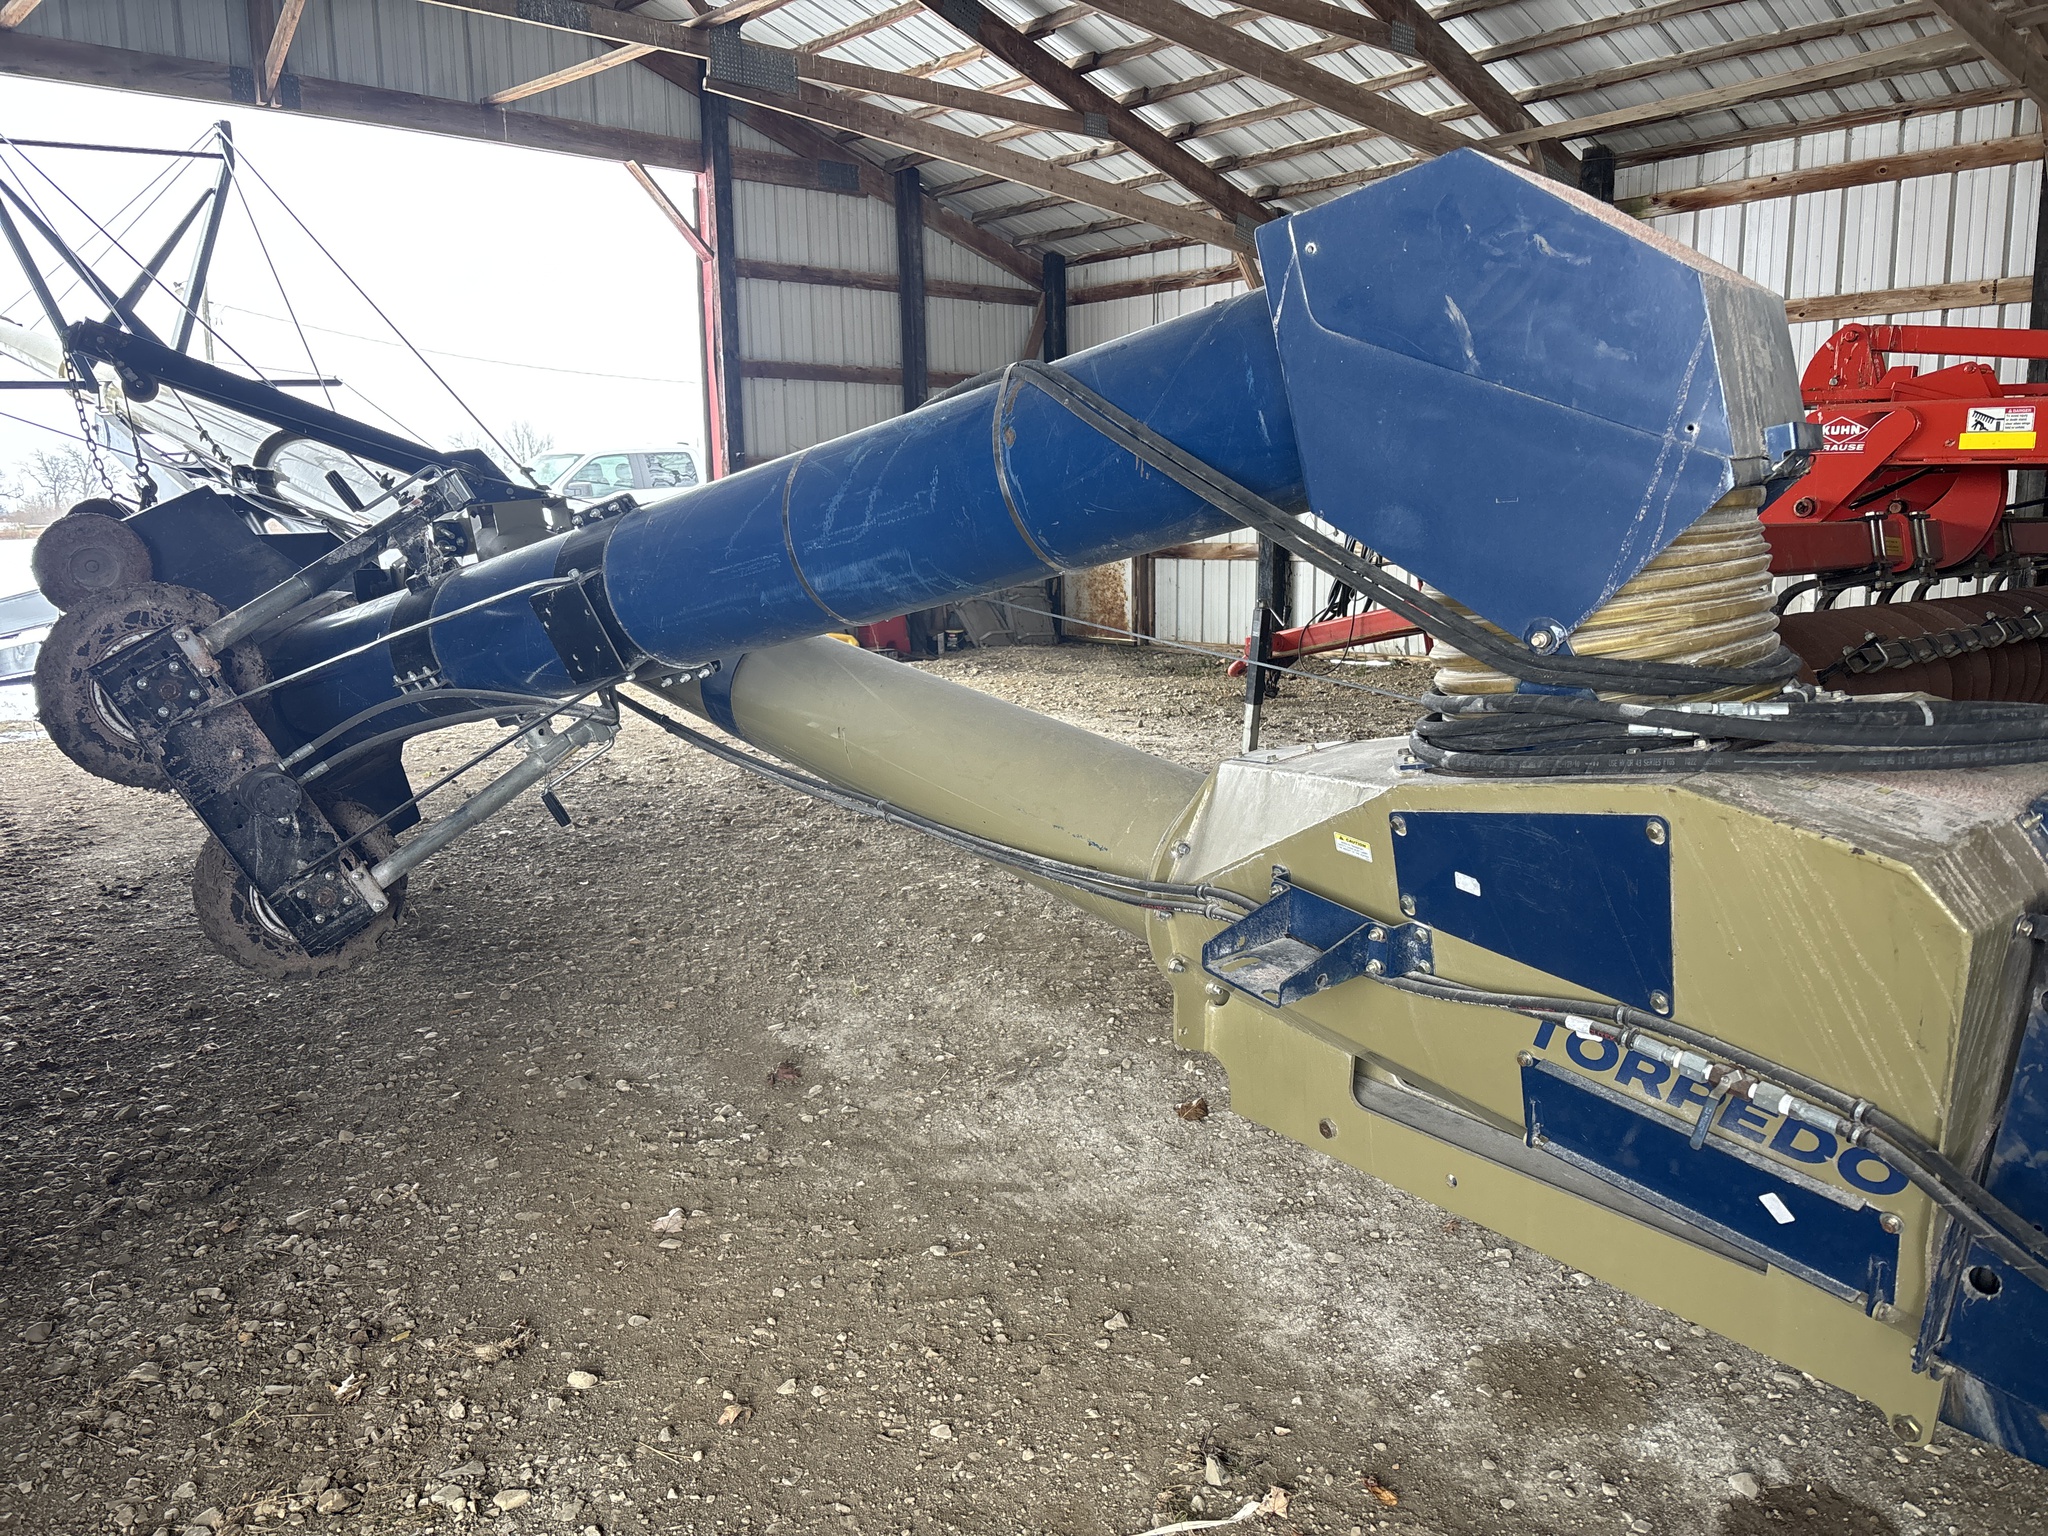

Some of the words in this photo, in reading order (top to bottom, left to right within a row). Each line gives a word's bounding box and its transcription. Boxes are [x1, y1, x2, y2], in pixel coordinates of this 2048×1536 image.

[1822, 425, 1860, 435] KUHN
[1821, 443, 1865, 452] RAUSE
[1346, 837, 1366, 848] CAUTION
